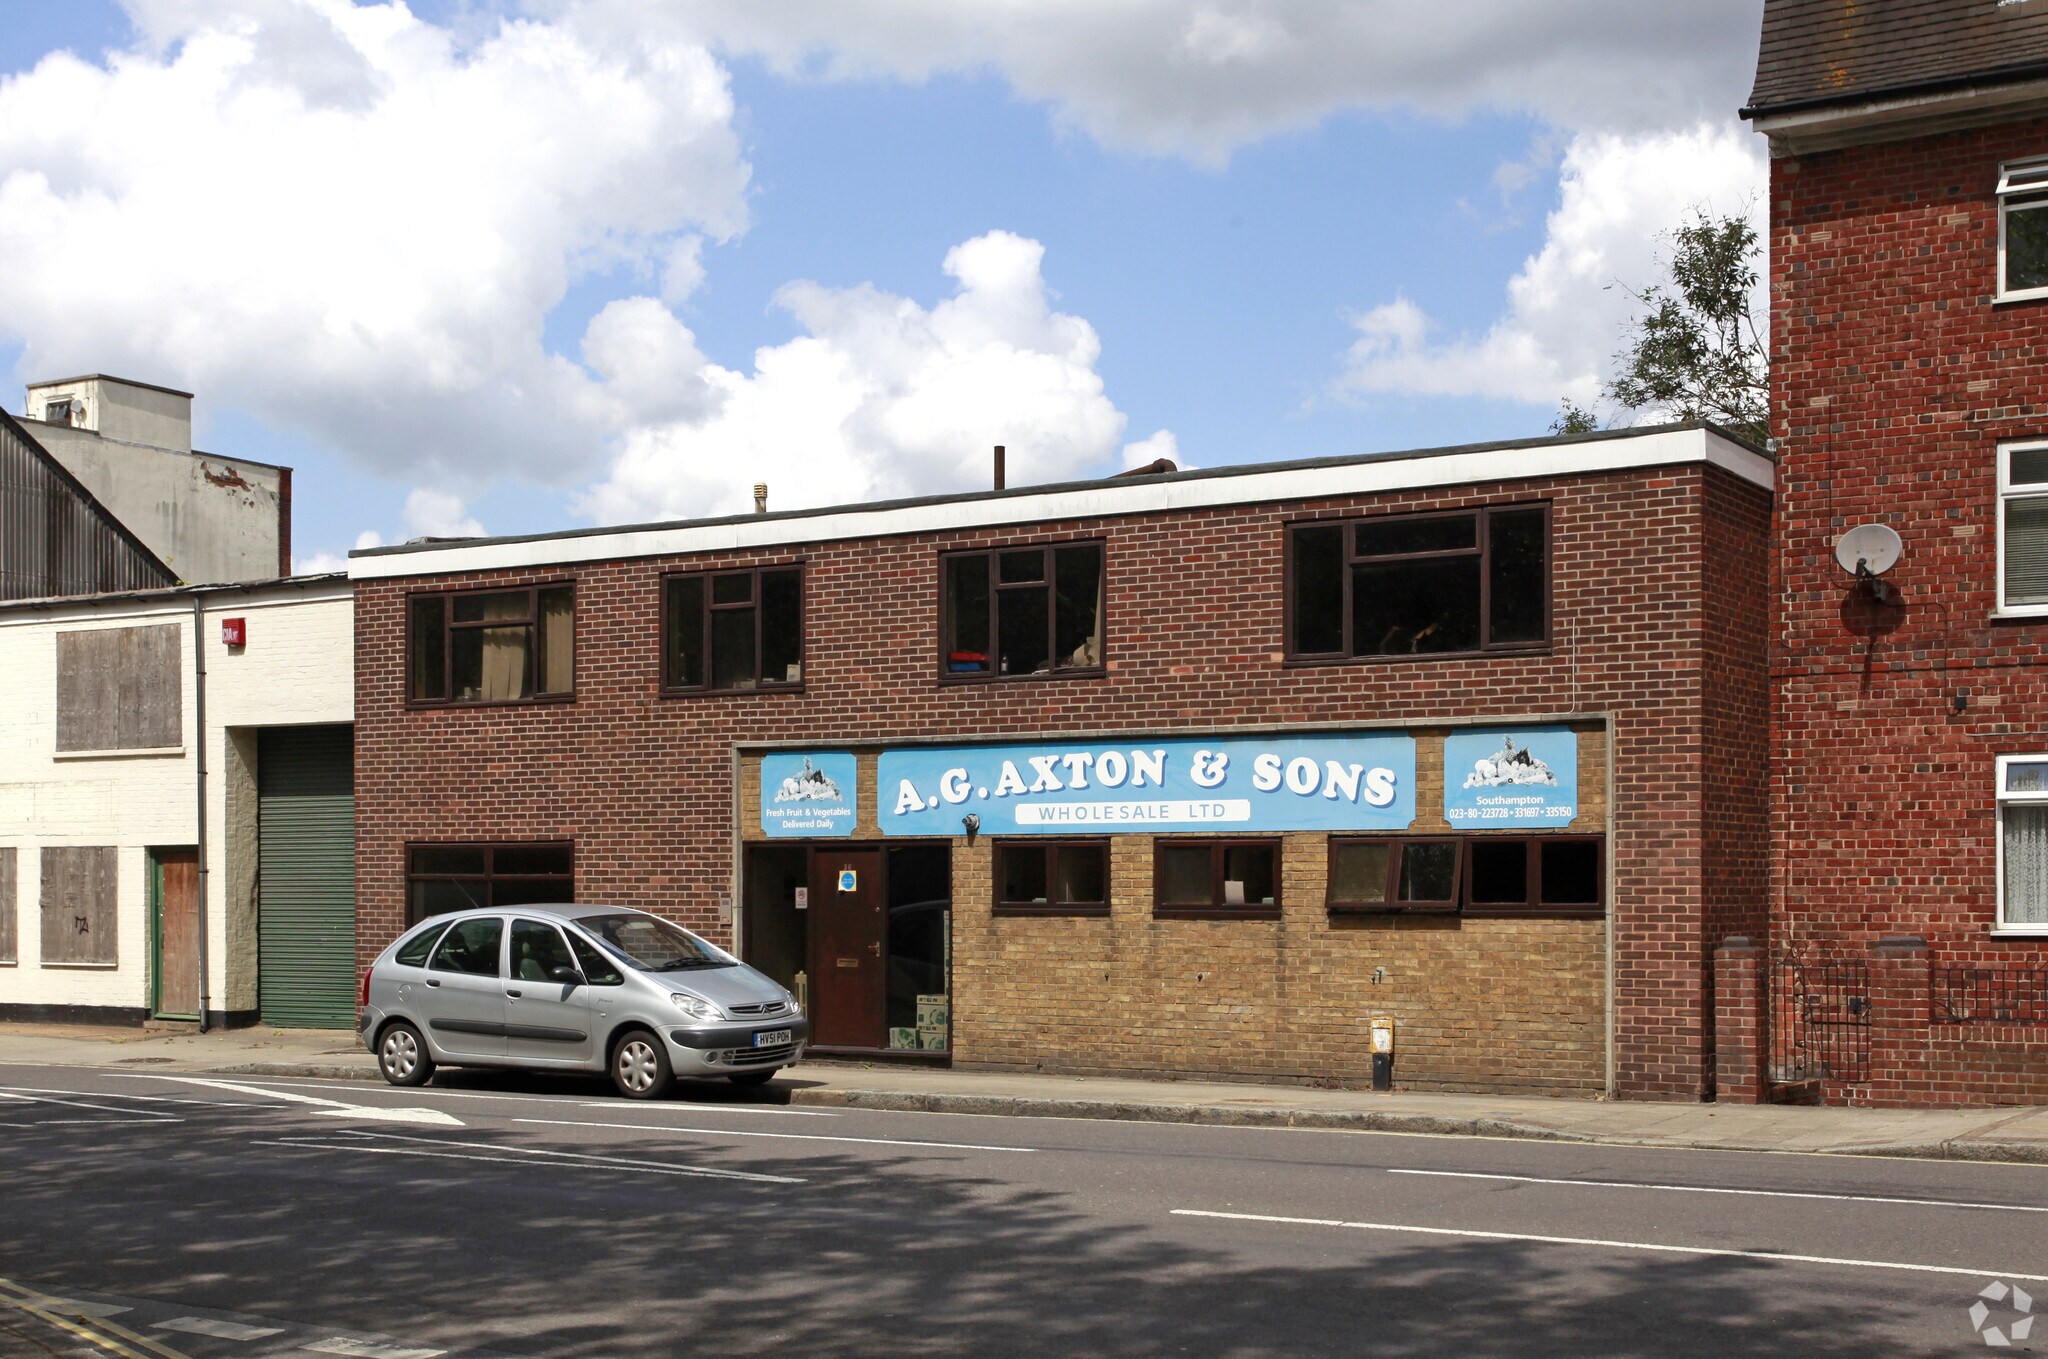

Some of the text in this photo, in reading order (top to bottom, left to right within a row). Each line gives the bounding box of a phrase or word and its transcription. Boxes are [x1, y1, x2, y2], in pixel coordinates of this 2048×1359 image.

[1190, 750, 1230, 789] &
[1252, 753, 1397, 808] SONS
[1476, 795, 1544, 806] Southampton
[766, 807, 851, 818] Fresh Fruit & Vegetables
[1038, 803, 1225, 821] WHOLESALE LTD
[1514, 806, 1539, 818] 331697
[1545, 805, 1572, 817] 335150
[782, 819, 834, 830] Delivered Daily
